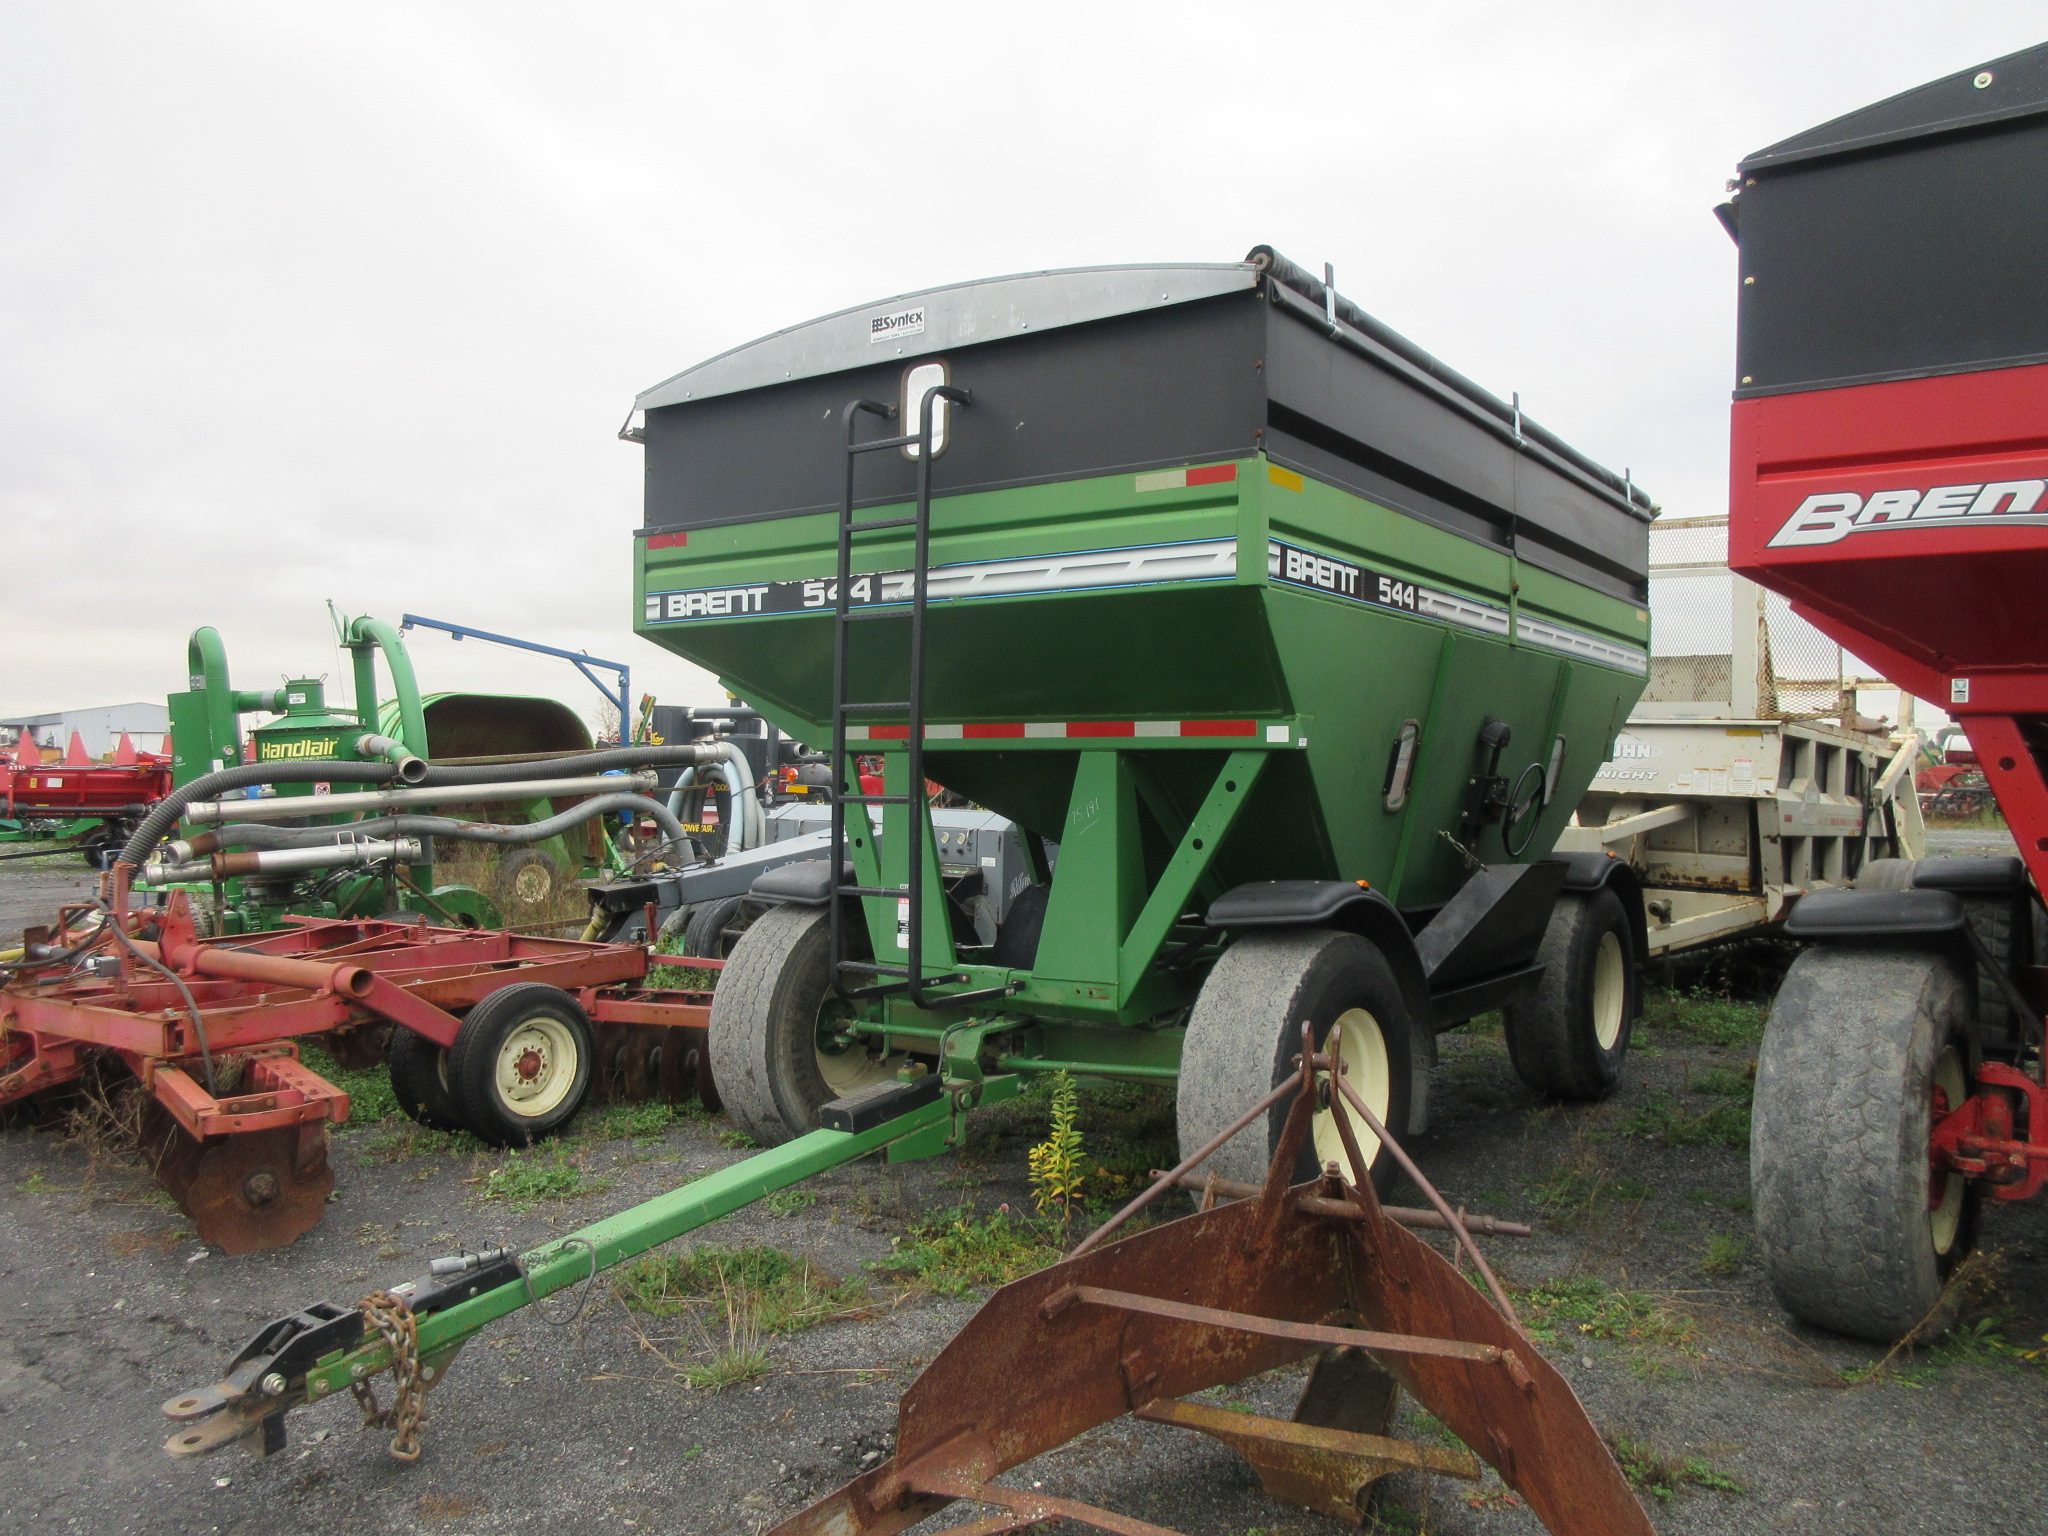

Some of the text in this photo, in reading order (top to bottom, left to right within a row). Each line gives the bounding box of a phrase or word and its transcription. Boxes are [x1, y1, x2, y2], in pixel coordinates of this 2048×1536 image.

[883, 311, 923, 329] Syntex
[1765, 480, 2048, 548] BREN
[1286, 549, 1415, 609] BRENT 544
[668, 587, 769, 618] BRENT
[262, 737, 338, 759] Handlair
[1613, 743, 1651, 758] UHN
[1597, 770, 1658, 780] NIGHT
